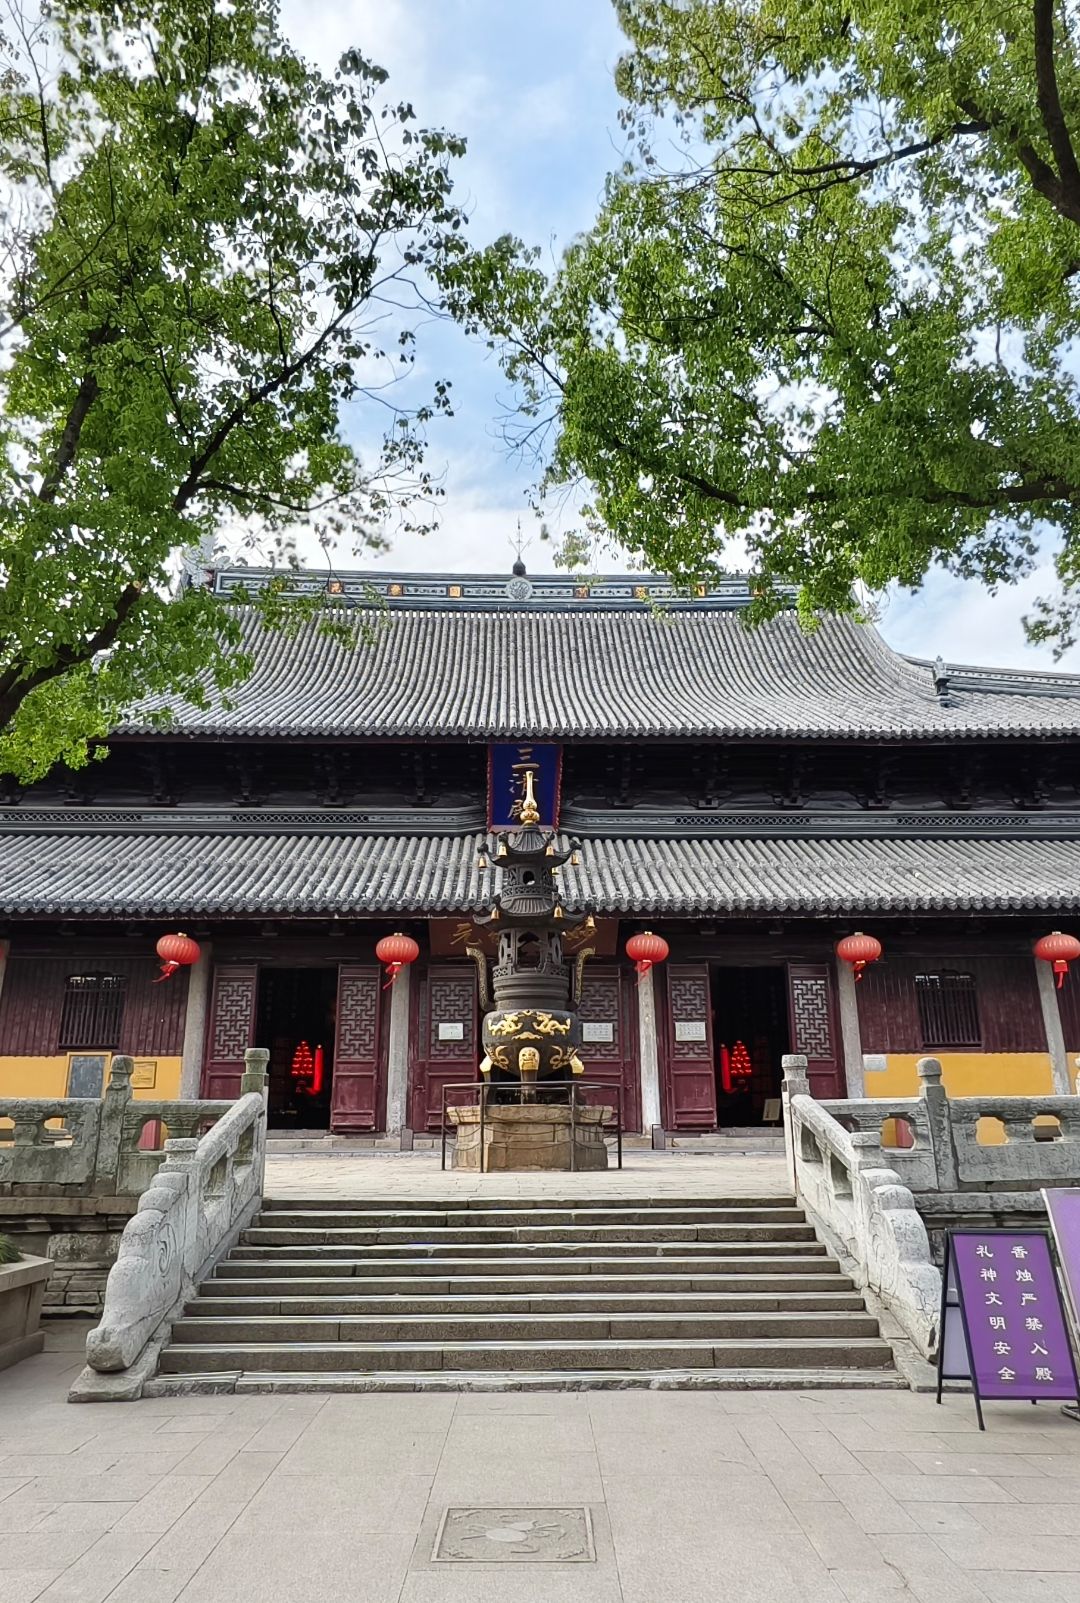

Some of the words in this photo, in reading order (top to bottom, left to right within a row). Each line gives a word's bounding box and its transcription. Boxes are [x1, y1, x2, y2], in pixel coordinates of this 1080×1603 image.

[976, 1244, 1016, 1380] 礼神文明安全
[1010, 1245, 1054, 1381] 香烛严禁入殿
